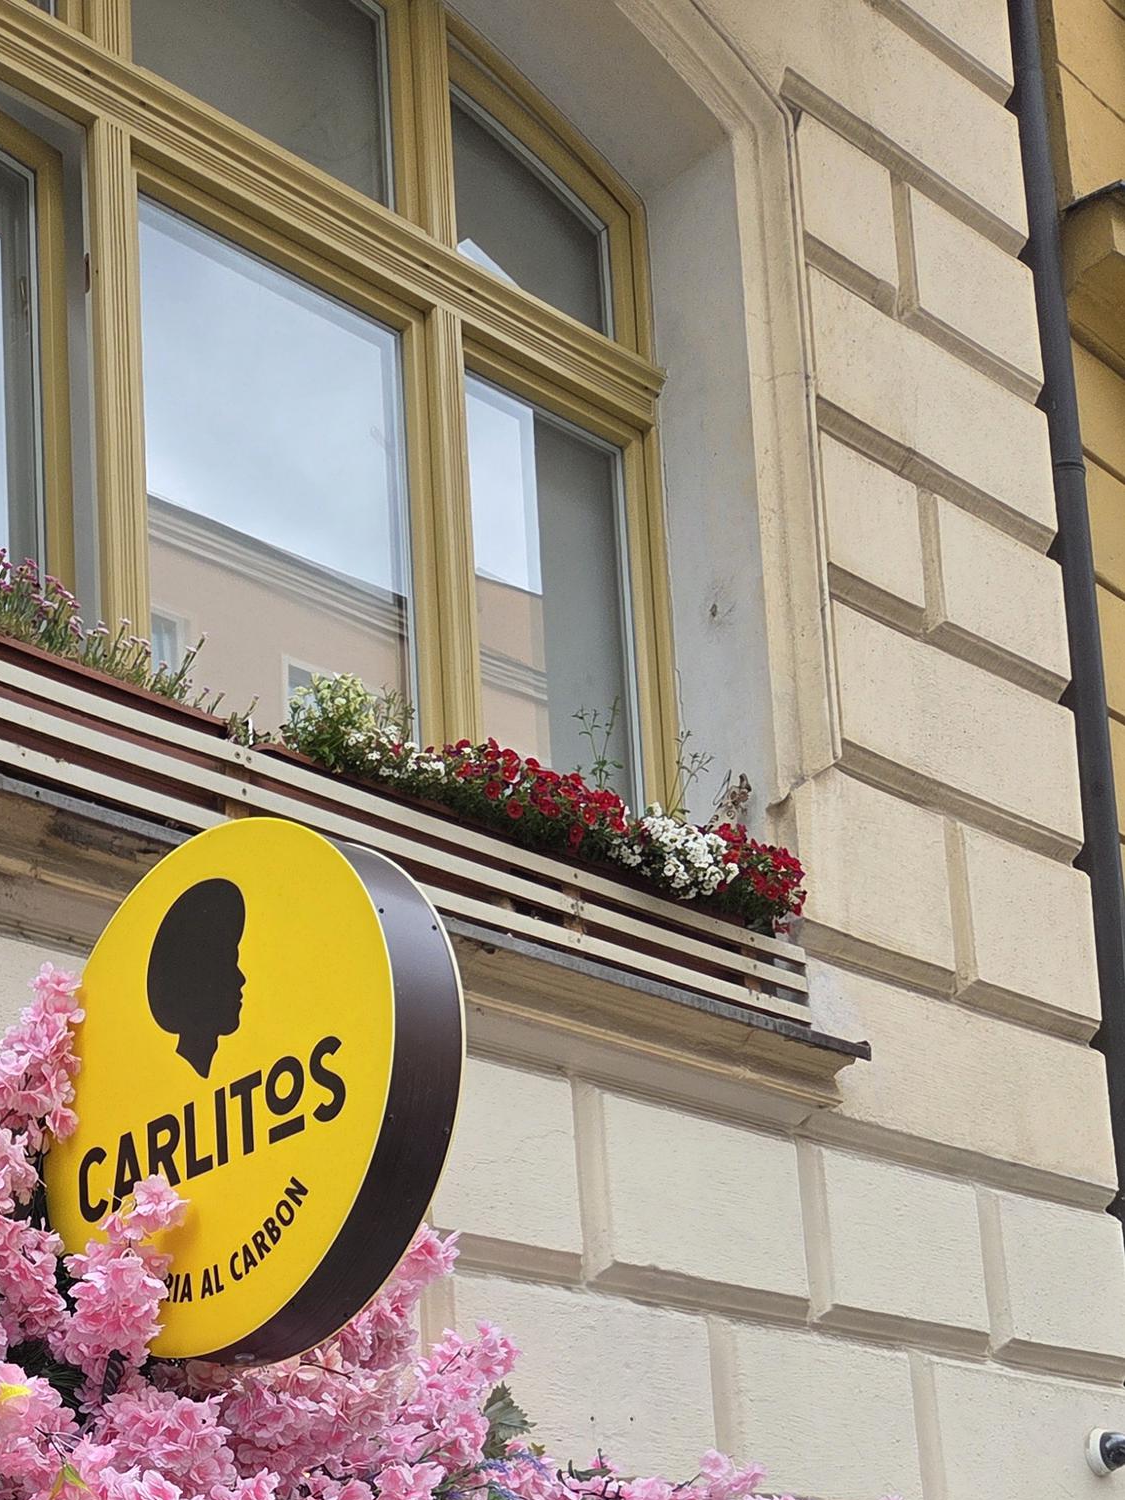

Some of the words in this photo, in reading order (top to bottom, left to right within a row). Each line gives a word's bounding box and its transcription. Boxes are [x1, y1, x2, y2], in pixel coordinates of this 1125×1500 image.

[79, 1036, 346, 1222] CARLITOS
[201, 1264, 224, 1299] AL
[230, 1176, 309, 1281] CARBON
